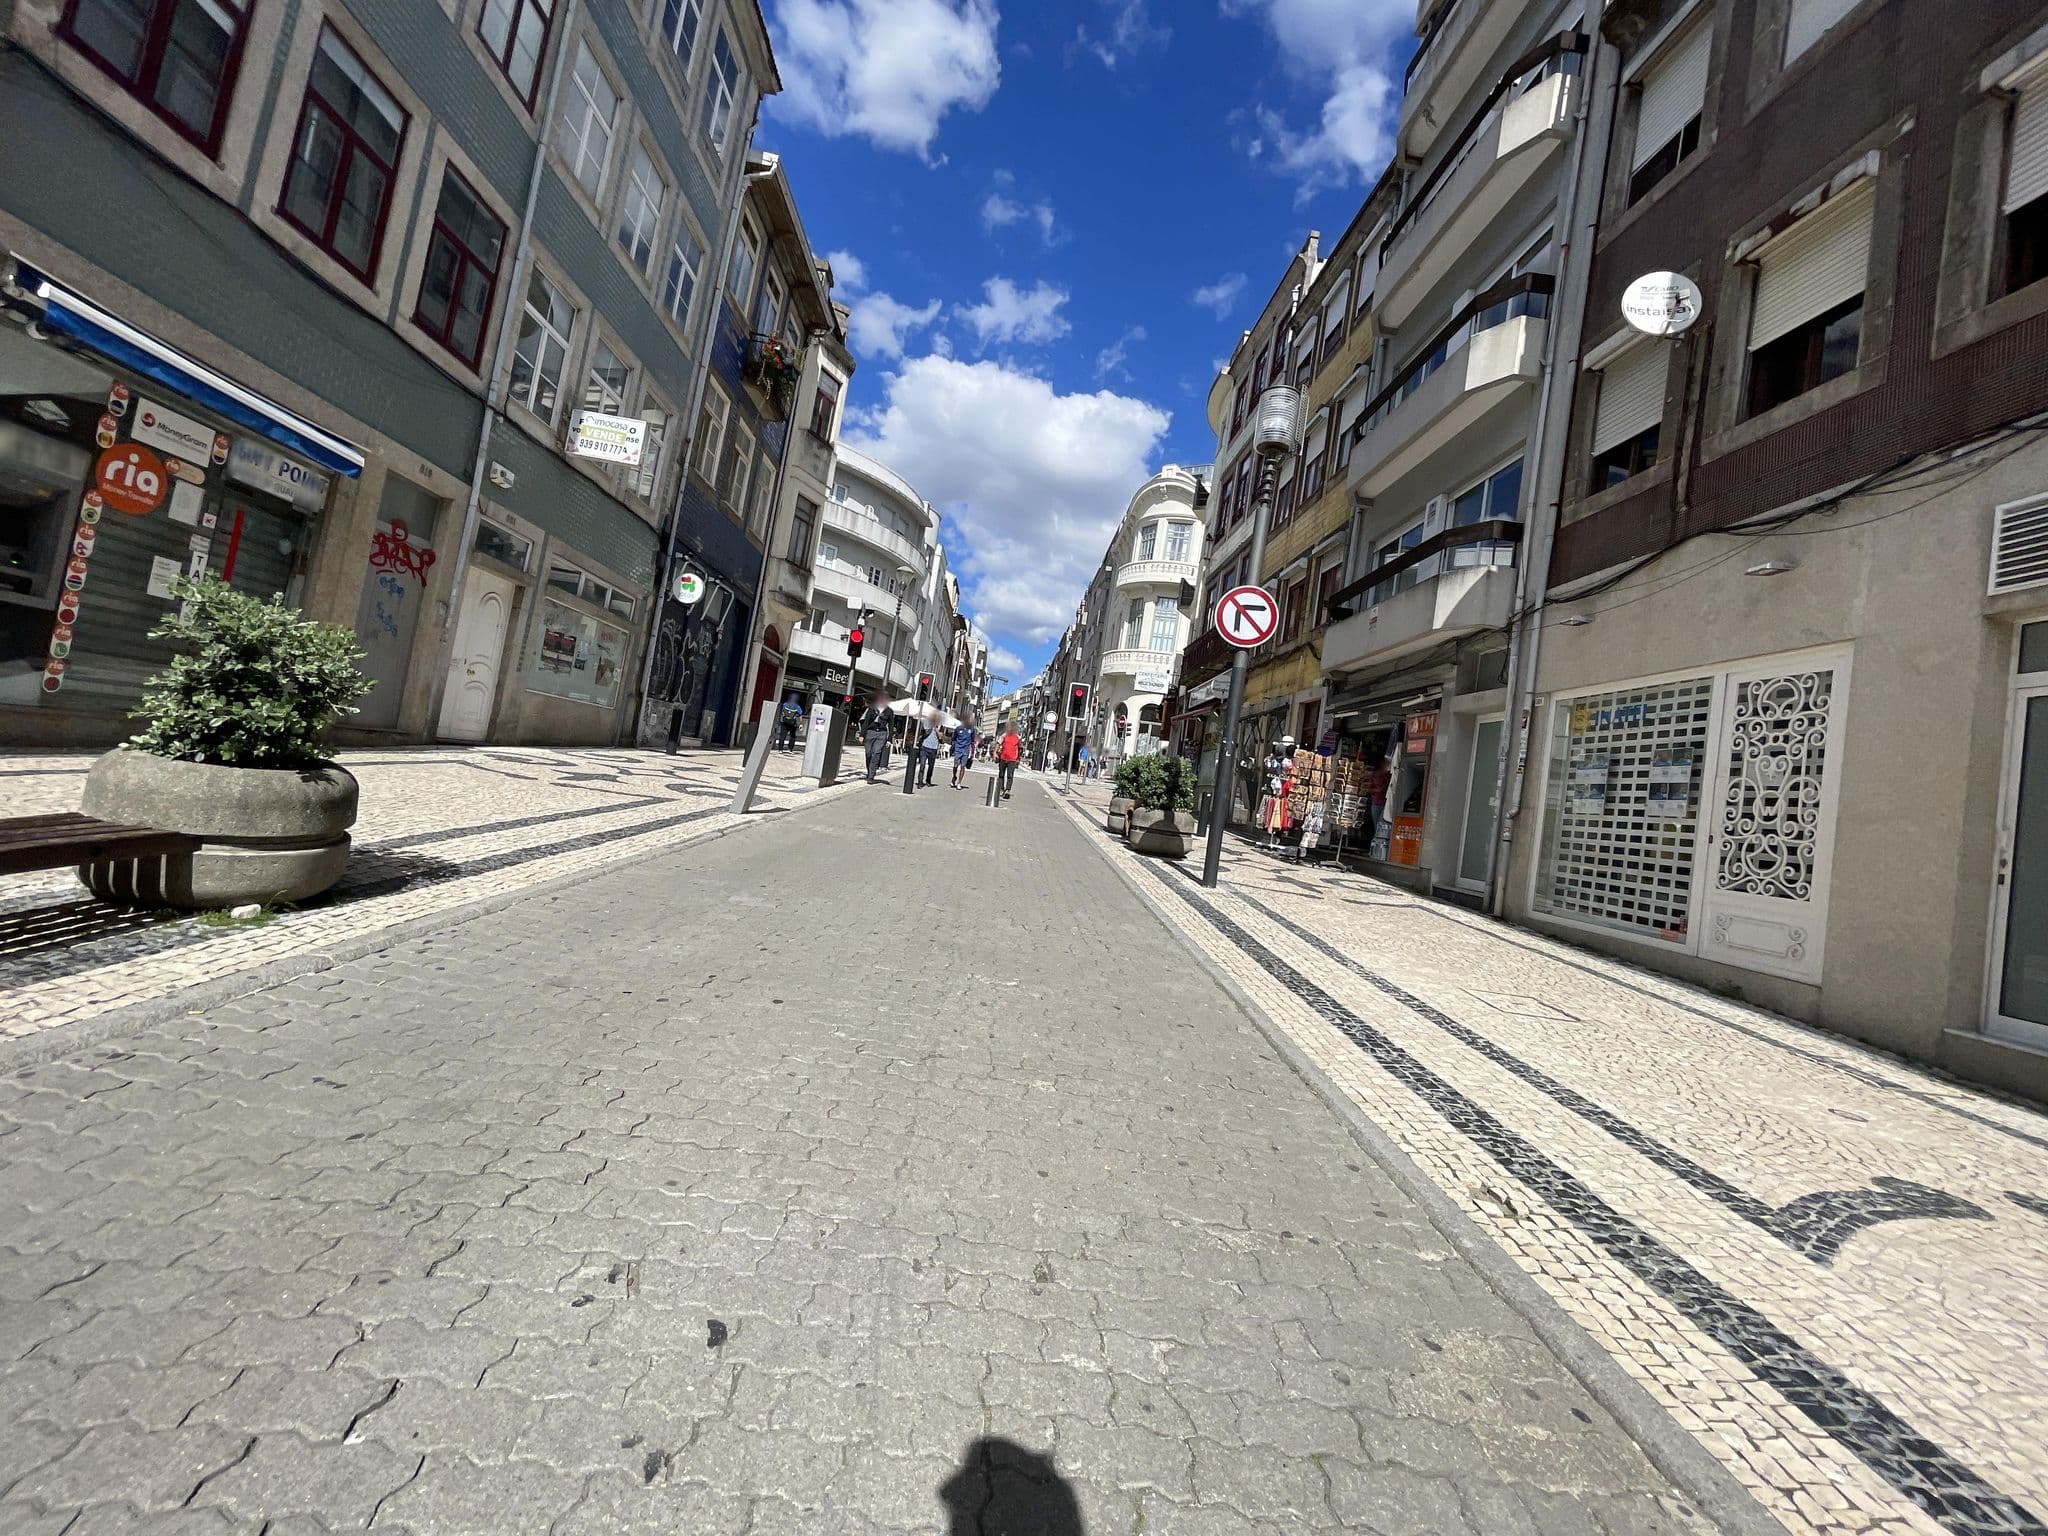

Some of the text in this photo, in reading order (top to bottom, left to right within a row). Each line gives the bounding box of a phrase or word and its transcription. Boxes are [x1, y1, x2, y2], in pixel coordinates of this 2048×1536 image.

[101, 415, 116, 426] ria
[157, 422, 208, 449] MoneyGram
[585, 427, 623, 445] VENDE
[104, 452, 160, 496] ria
[80, 524, 95, 535] ria
[71, 558, 87, 570] ria
